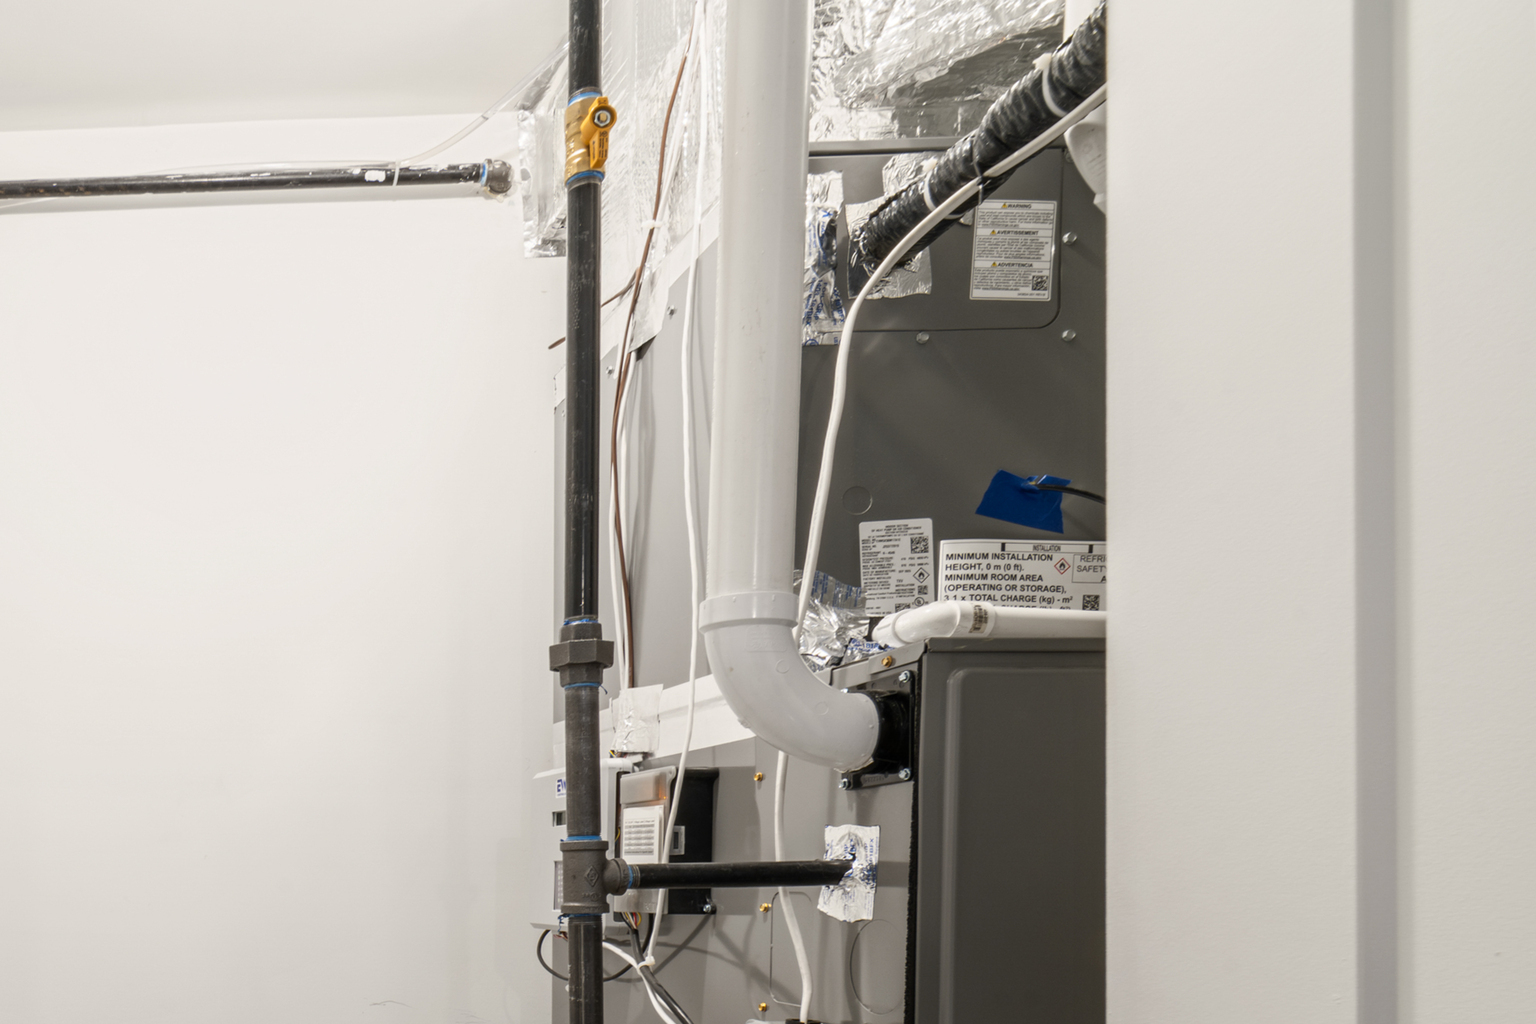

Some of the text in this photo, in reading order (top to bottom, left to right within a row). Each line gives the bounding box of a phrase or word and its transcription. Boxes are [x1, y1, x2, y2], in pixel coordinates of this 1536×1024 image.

[1032, 544, 1061, 552] INSTALLATION
[991, 553, 1053, 561] INSTALLATION
[945, 562, 983, 571] HEIGHT,
[1002, 562, 1011, 572] (0
[1012, 562, 1024, 572] ft).
[1018, 574, 1043, 582] AREA
[944, 583, 1002, 592] (OPERATING
[1019, 584, 1067, 594] STORAGE),
[968, 594, 998, 602] TOTAL
[999, 594, 1037, 603] CHARGE
[1038, 594, 1055, 604] (kg)
